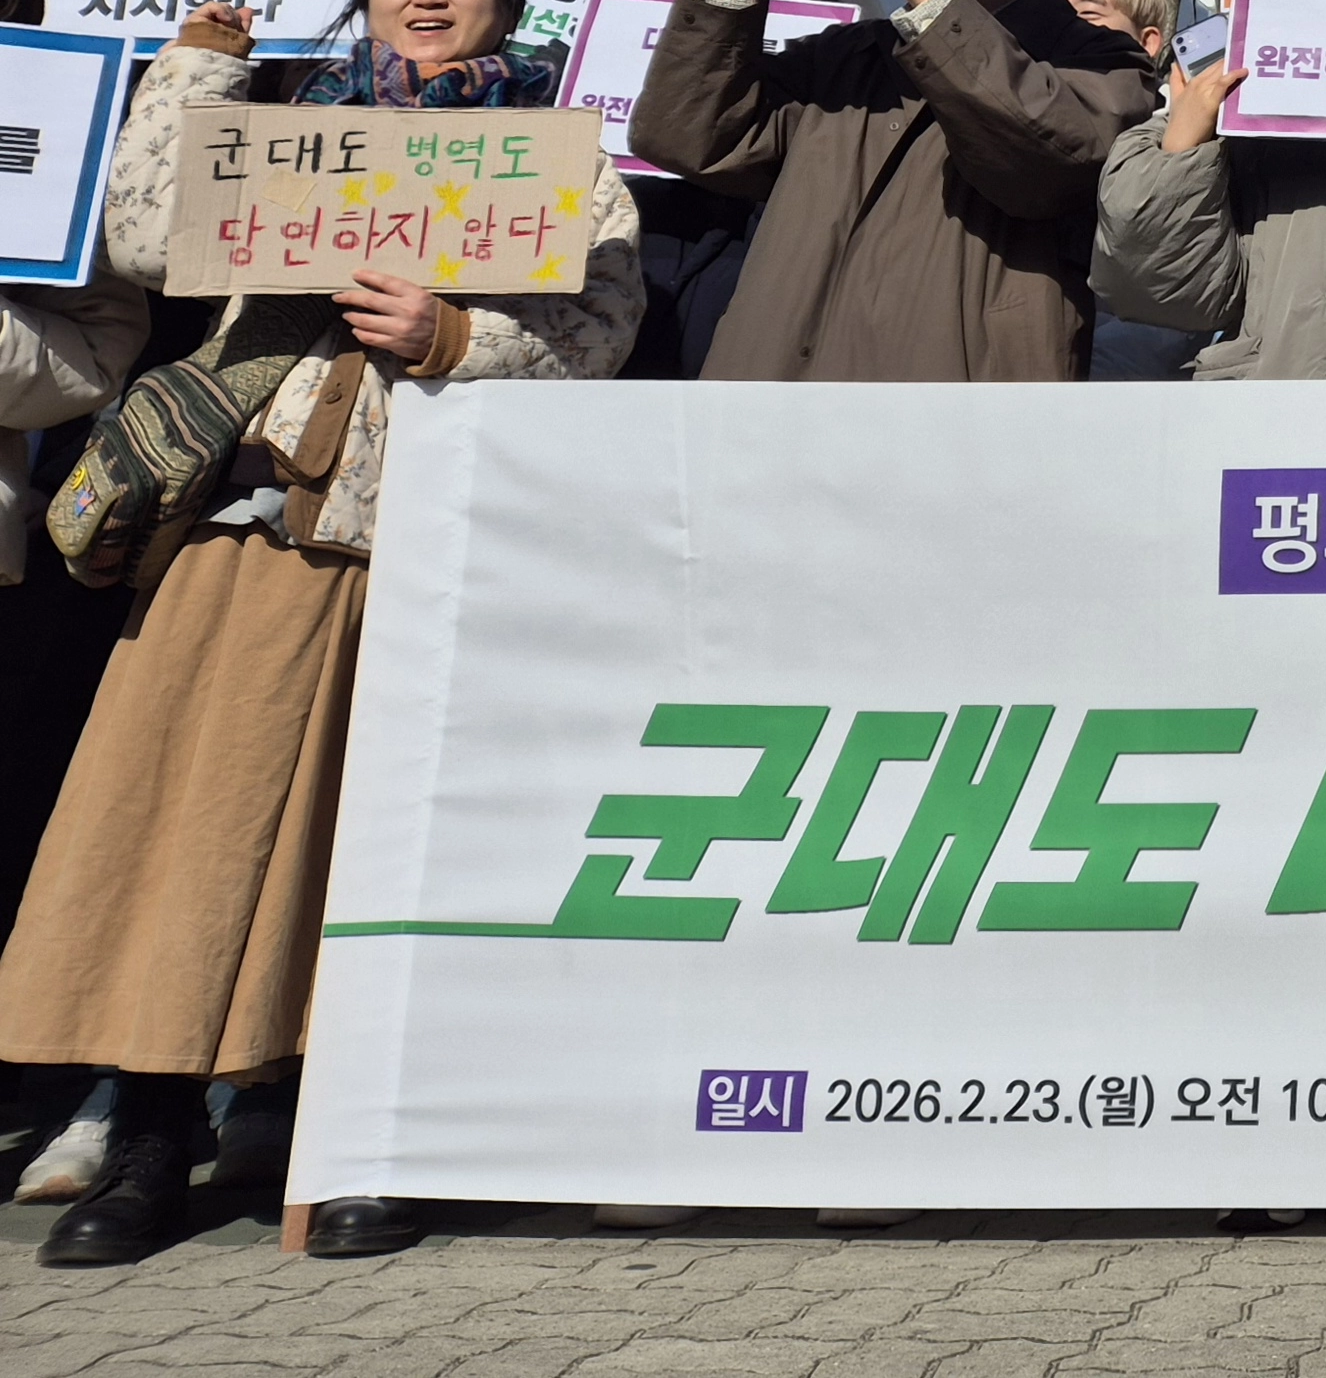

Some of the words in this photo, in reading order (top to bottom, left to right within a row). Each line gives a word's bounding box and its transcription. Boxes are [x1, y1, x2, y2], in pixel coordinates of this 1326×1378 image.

[205, 128, 370, 181] 군대도
[404, 132, 542, 180] 병역도
[463, 204, 557, 260] 않다
[550, 702, 1259, 944] 군대도
[706, 1074, 794, 1127] 일시
[824, 1075, 1156, 1129] 2026.2.23.(월)
[1170, 1075, 1261, 1127] 오전
